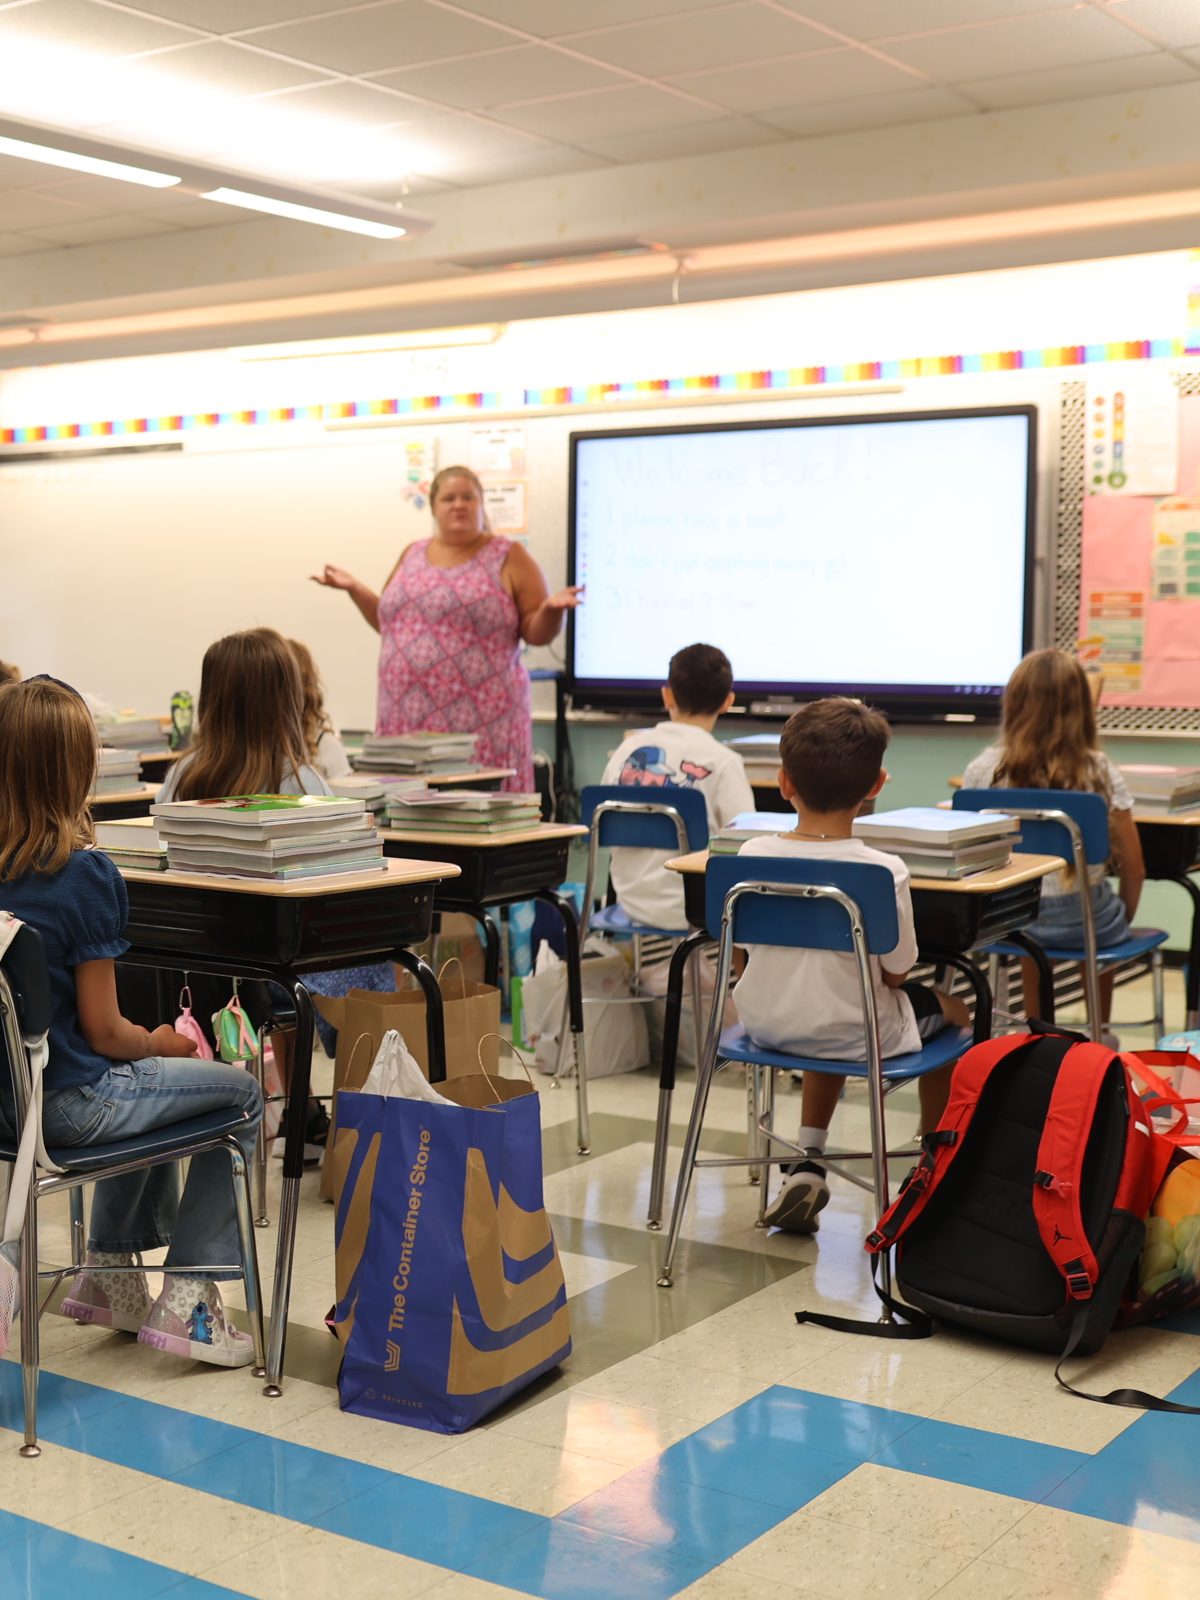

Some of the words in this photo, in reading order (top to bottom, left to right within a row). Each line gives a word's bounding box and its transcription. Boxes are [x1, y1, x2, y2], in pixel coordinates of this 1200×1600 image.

[609, 442, 749, 488] Welcome
[409, 1129, 431, 1185] Store
[393, 1187, 422, 1291] Container
[388, 1293, 406, 1332] The
[382, 1394, 423, 1409] RECYCLED
